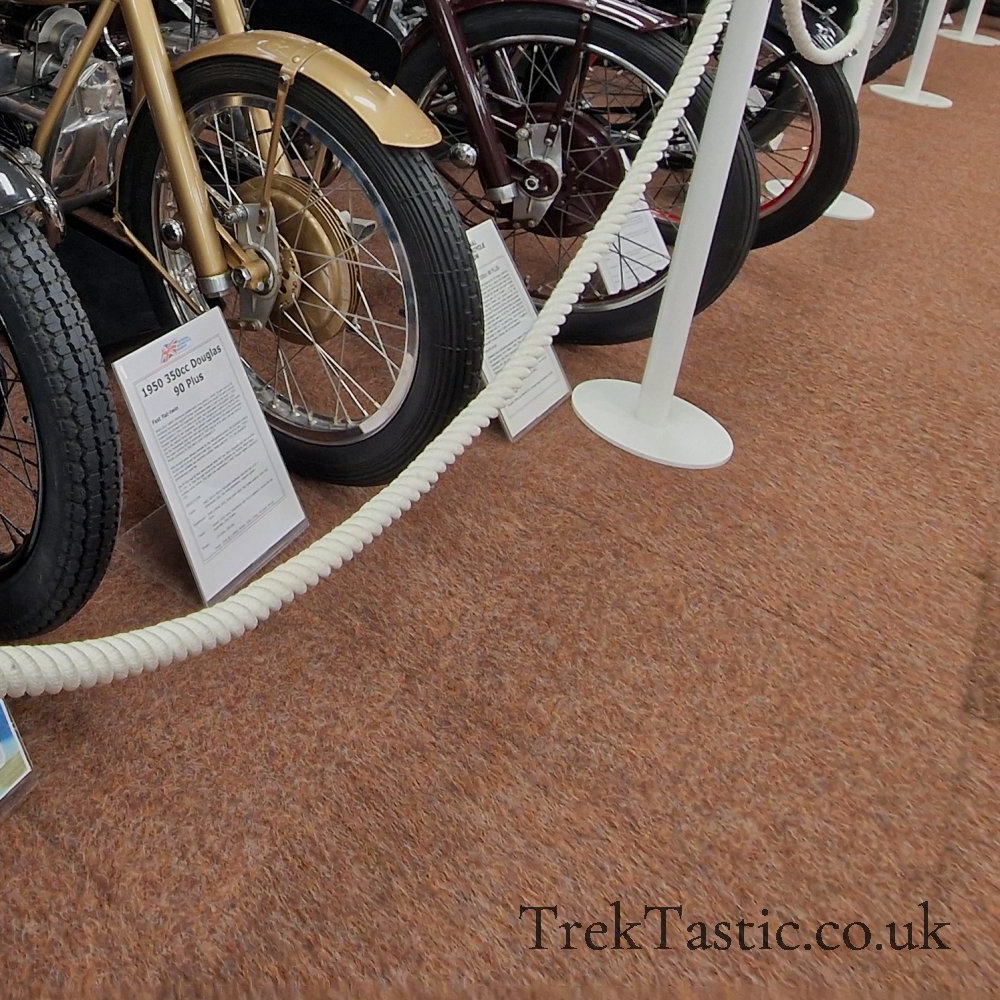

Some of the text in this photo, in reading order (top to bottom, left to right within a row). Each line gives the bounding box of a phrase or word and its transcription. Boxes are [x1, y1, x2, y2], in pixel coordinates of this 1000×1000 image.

[141, 344, 222, 398] 1950 350cc Douglas
[173, 371, 205, 396] 90 Plus
